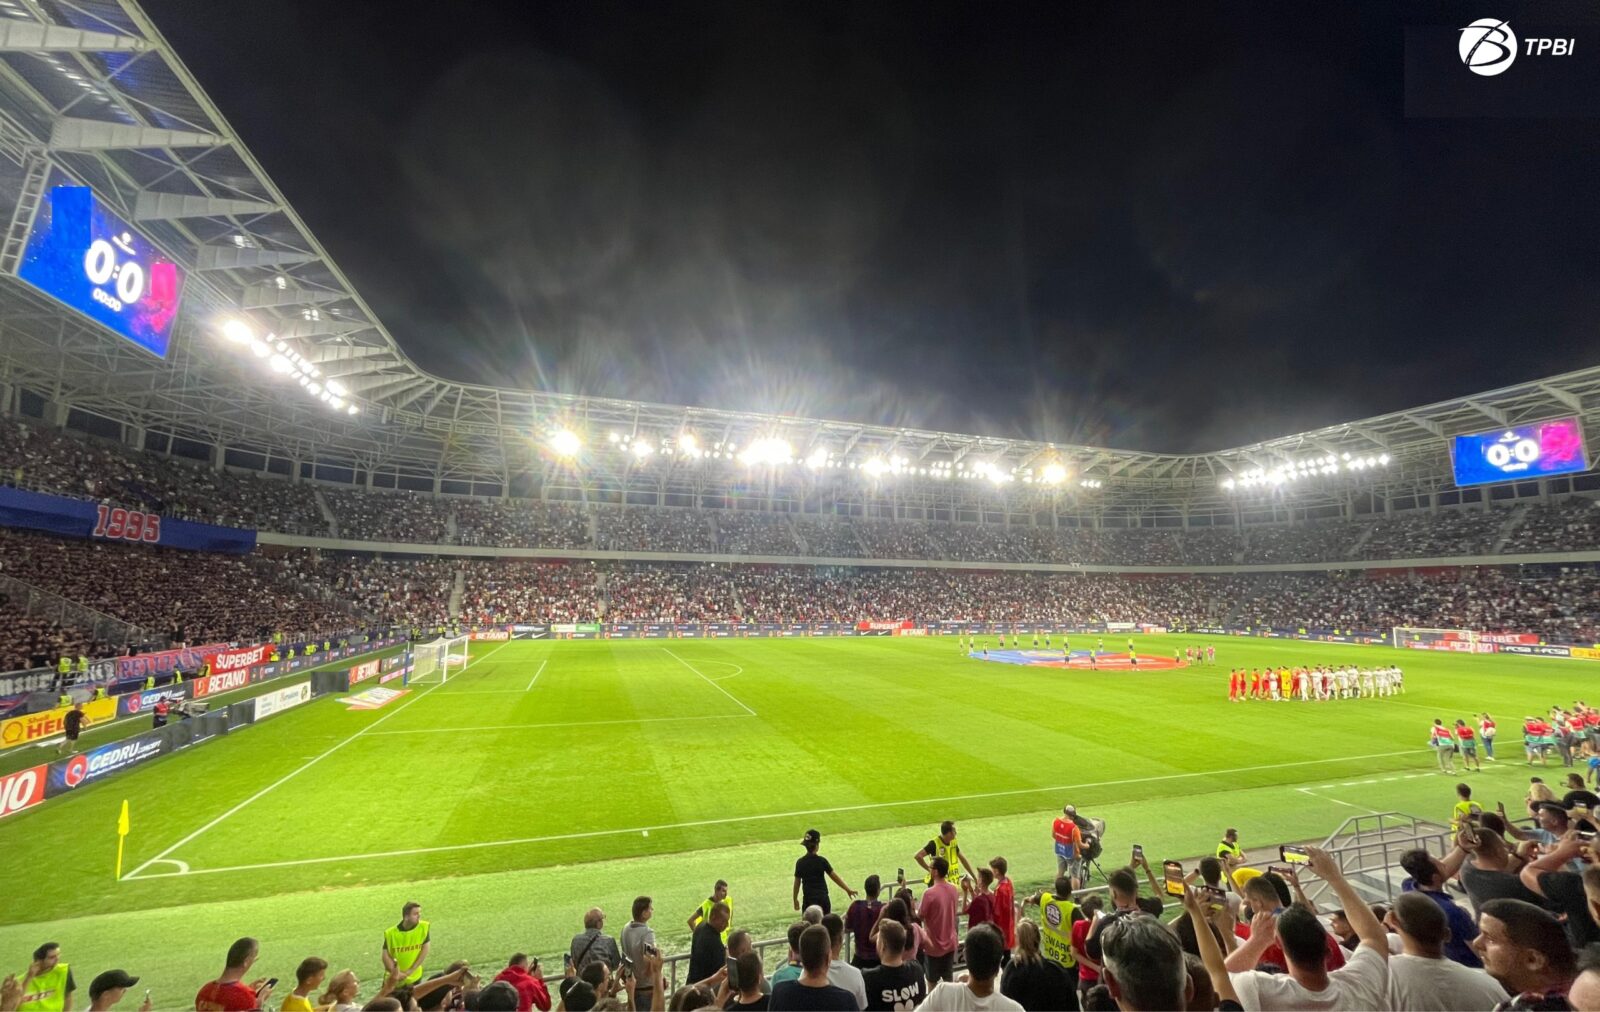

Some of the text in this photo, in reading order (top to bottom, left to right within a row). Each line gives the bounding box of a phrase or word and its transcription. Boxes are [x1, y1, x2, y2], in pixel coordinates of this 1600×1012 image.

[85, 239, 144, 304] 0:0
[93, 504, 161, 543] 1995
[215, 647, 265, 670] SUPERBET
[208, 670, 246, 693] BETANO
[27, 718, 66, 739] HEL
[89, 741, 140, 772] CEDRU
[881, 981, 919, 1003] SLOW
